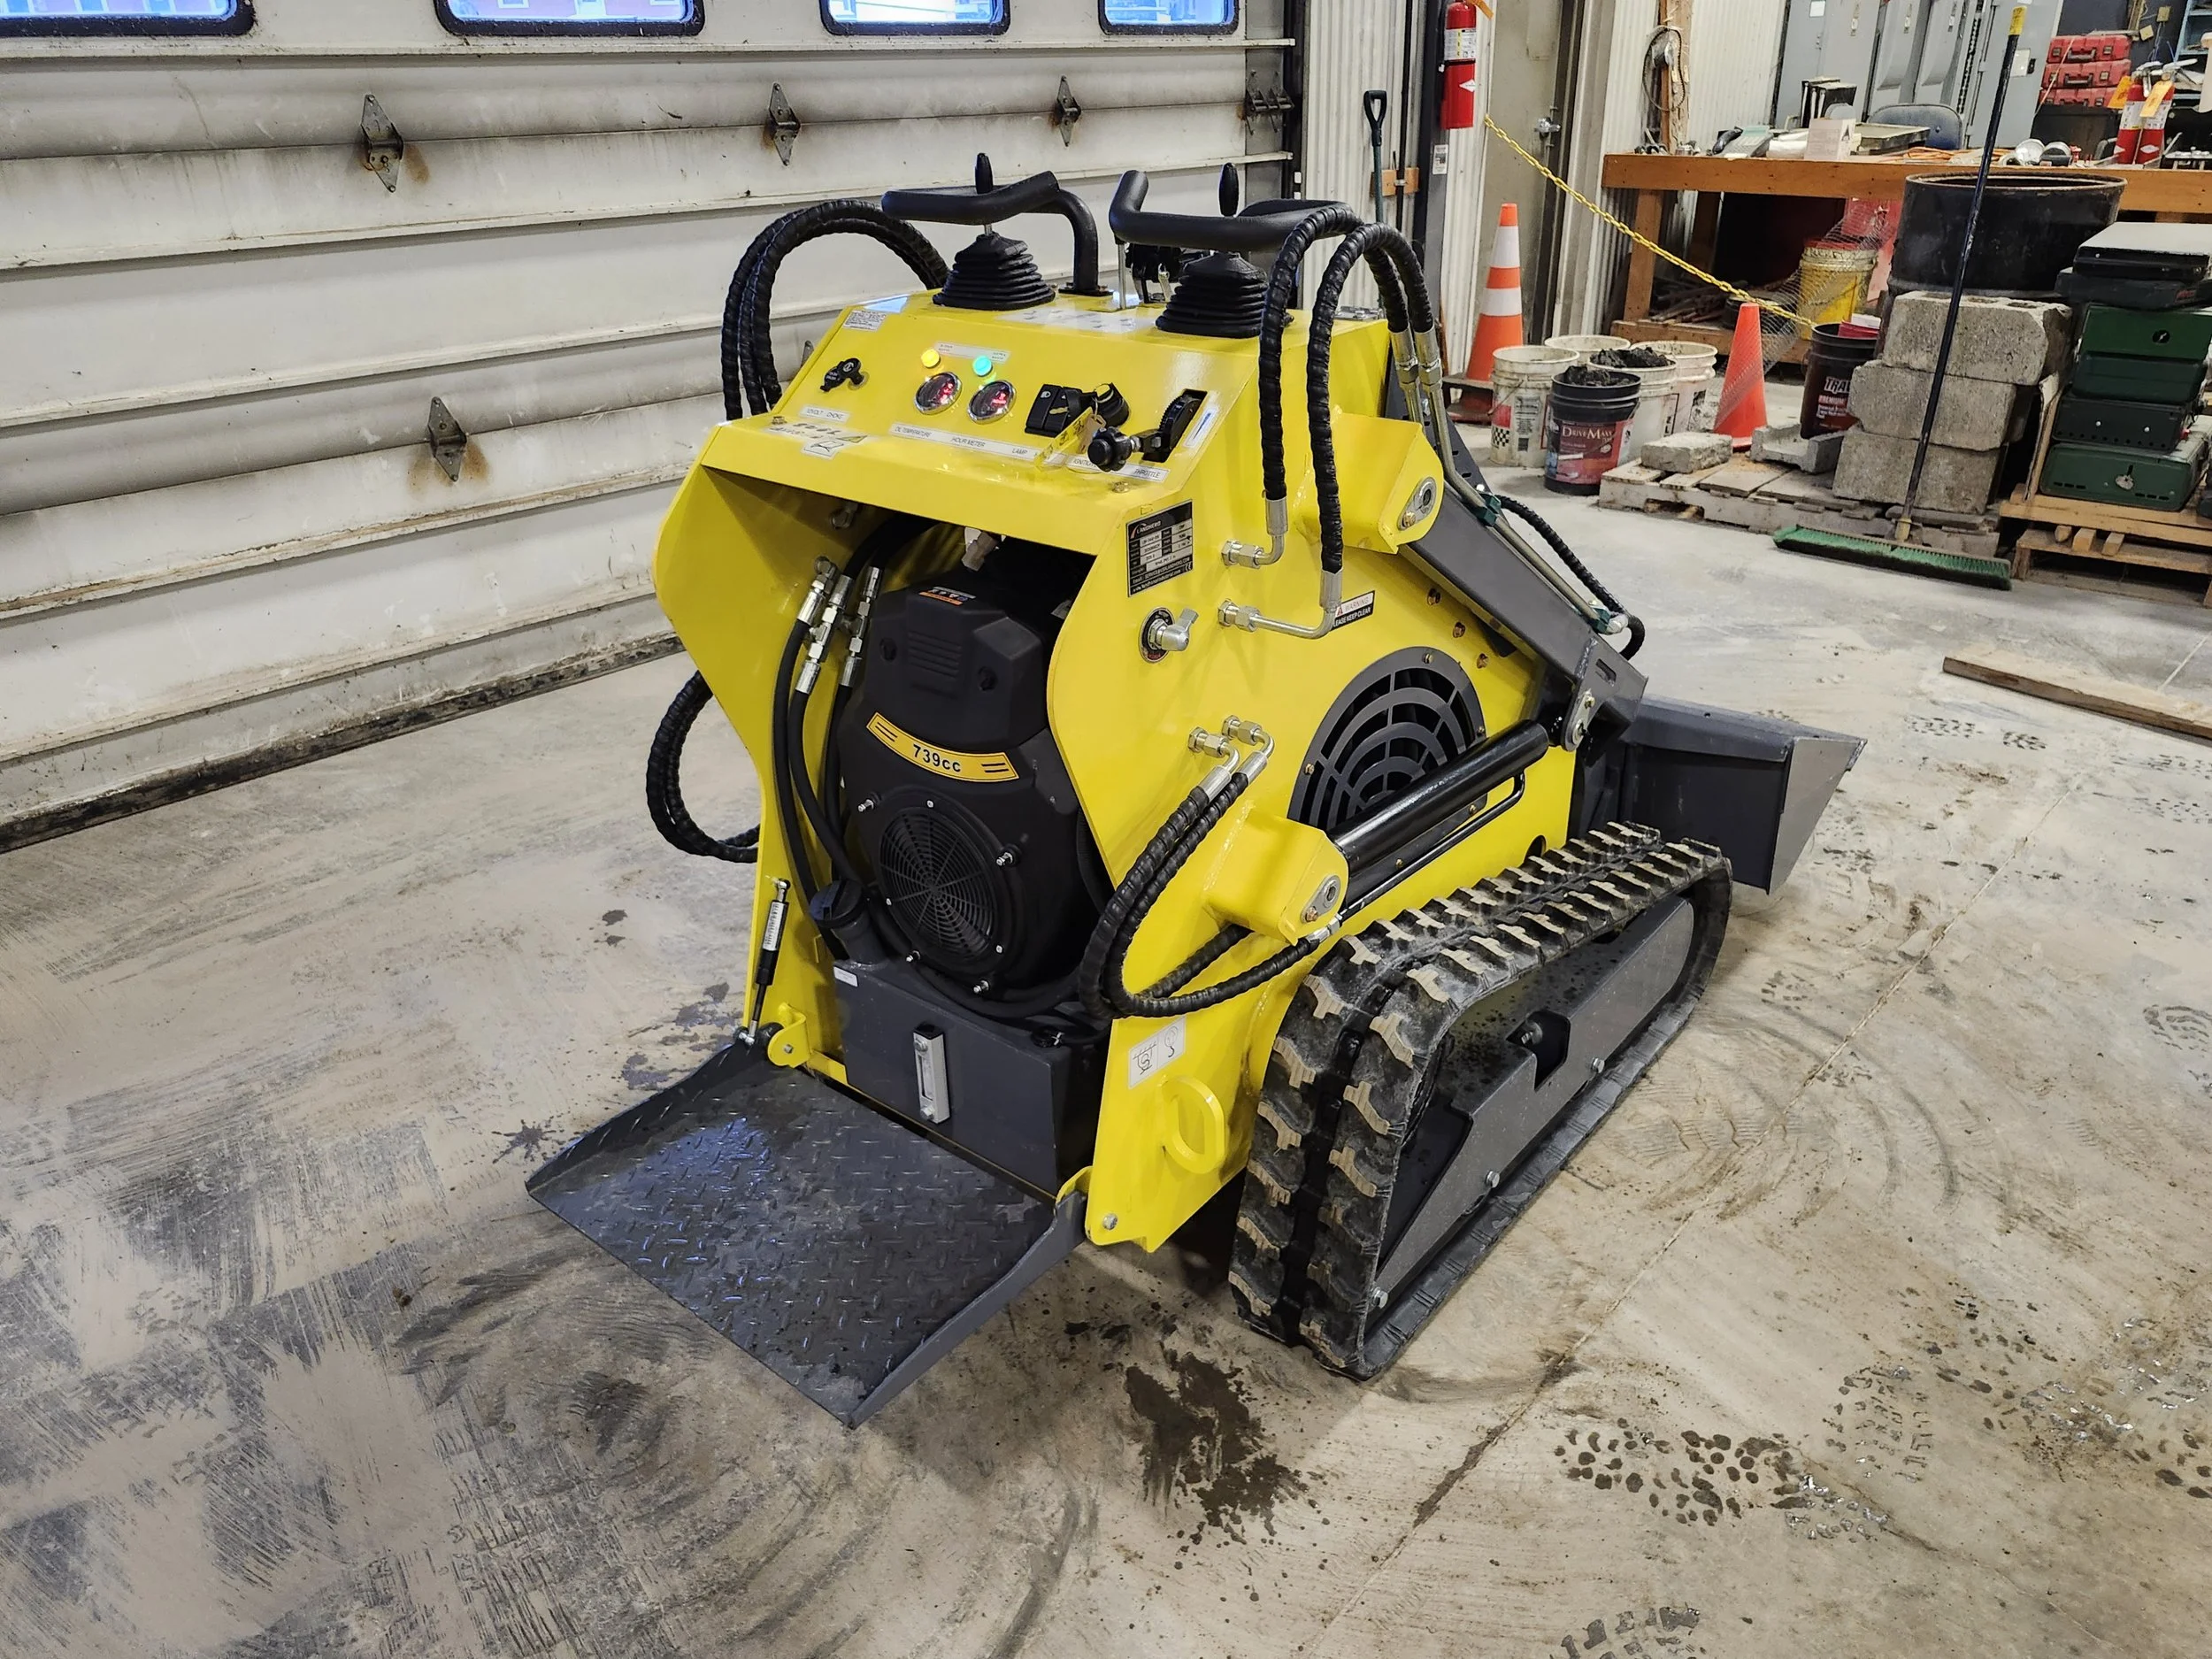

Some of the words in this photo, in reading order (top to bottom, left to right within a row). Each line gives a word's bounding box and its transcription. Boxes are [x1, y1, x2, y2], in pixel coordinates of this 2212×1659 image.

[1073, 458, 1096, 467] IGNITIO
[1133, 468, 1161, 479] THROTTLE
[1345, 596, 1369, 611] WARNING
[1333, 617, 1347, 626] LEASE
[1346, 611, 1358, 621] KEEP
[1357, 606, 1371, 618] CLEAR
[913, 744, 961, 772] 739cc
